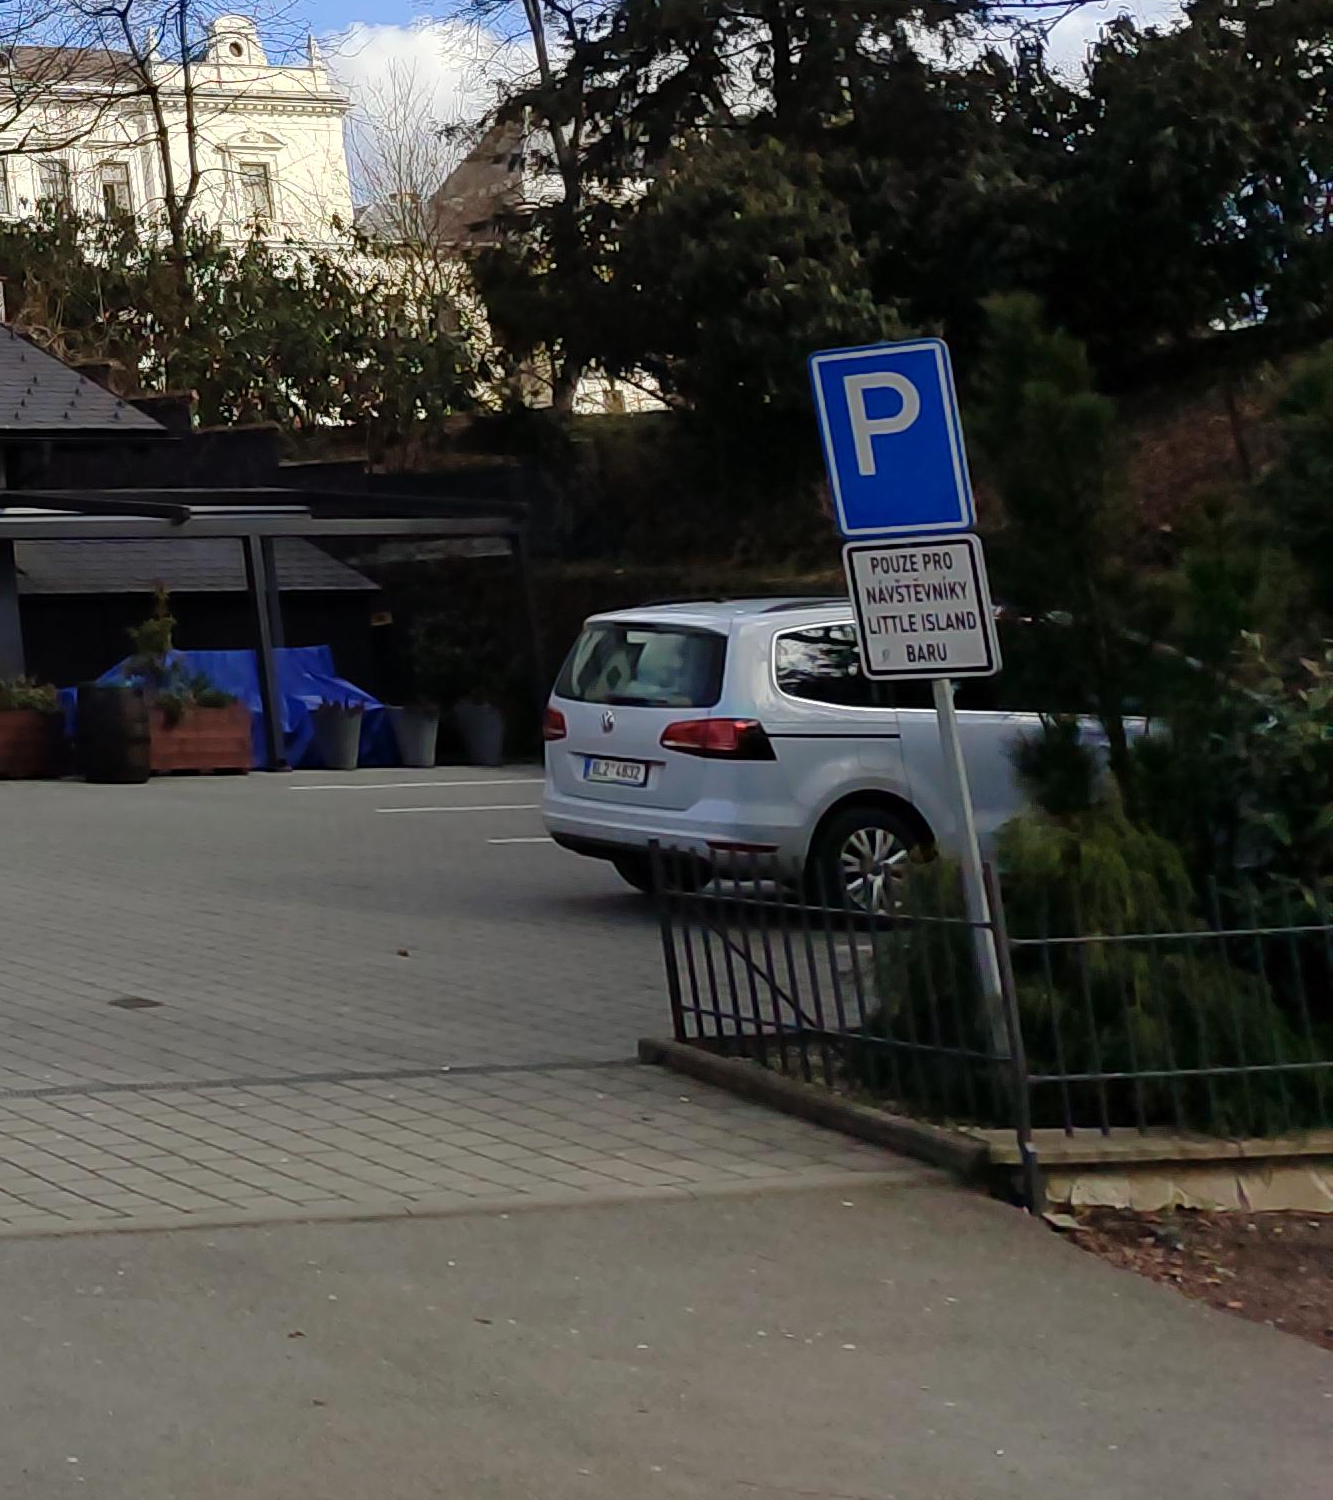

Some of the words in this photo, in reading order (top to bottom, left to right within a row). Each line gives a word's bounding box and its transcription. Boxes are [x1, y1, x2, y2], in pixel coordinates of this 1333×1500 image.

[843, 372, 921, 476] P
[870, 554, 920, 575] POUZE
[921, 551, 953, 571] PRO
[866, 576, 967, 605] NÁVŠTĚVNÍKY
[868, 613, 918, 635] LITTLE
[921, 611, 977, 632] ISLAND
[905, 642, 948, 663] BARU
